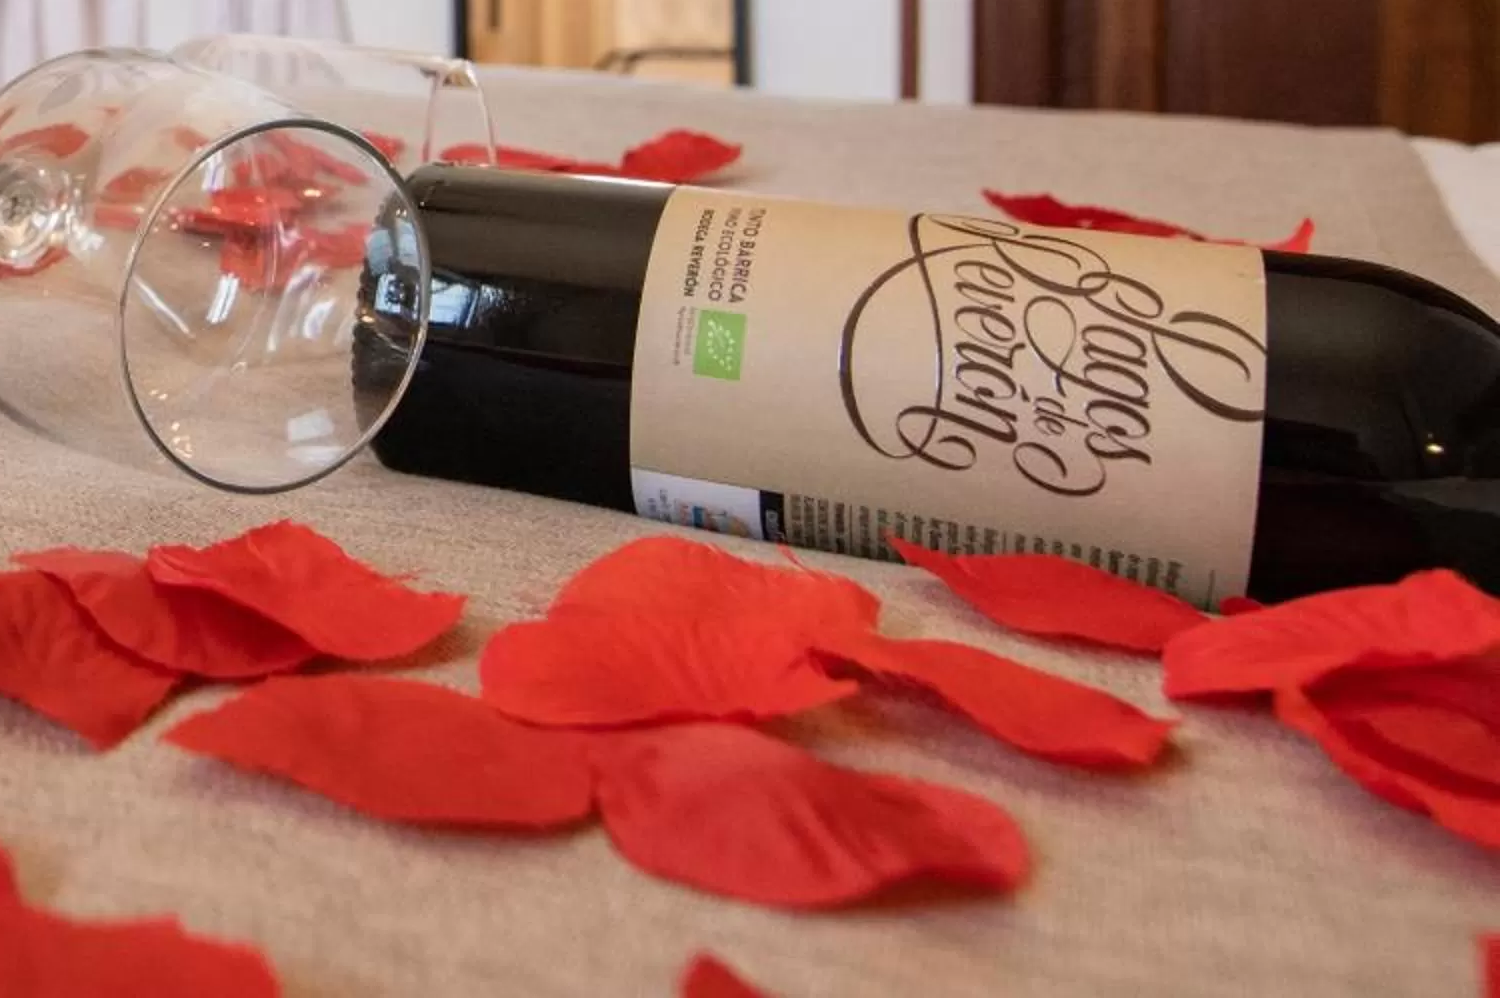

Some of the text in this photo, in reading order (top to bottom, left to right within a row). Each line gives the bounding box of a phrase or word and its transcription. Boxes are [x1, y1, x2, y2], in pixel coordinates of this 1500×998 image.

[695, 209, 716, 243] BODEGA
[683, 245, 706, 298] REVERÓN
[707, 229, 736, 302] ECOLÓGICO
[728, 239, 756, 303] BARRICA
[890, 213, 1111, 470] Reverón
[1018, 271, 1267, 494] Pagos
[1033, 396, 1089, 437] de
